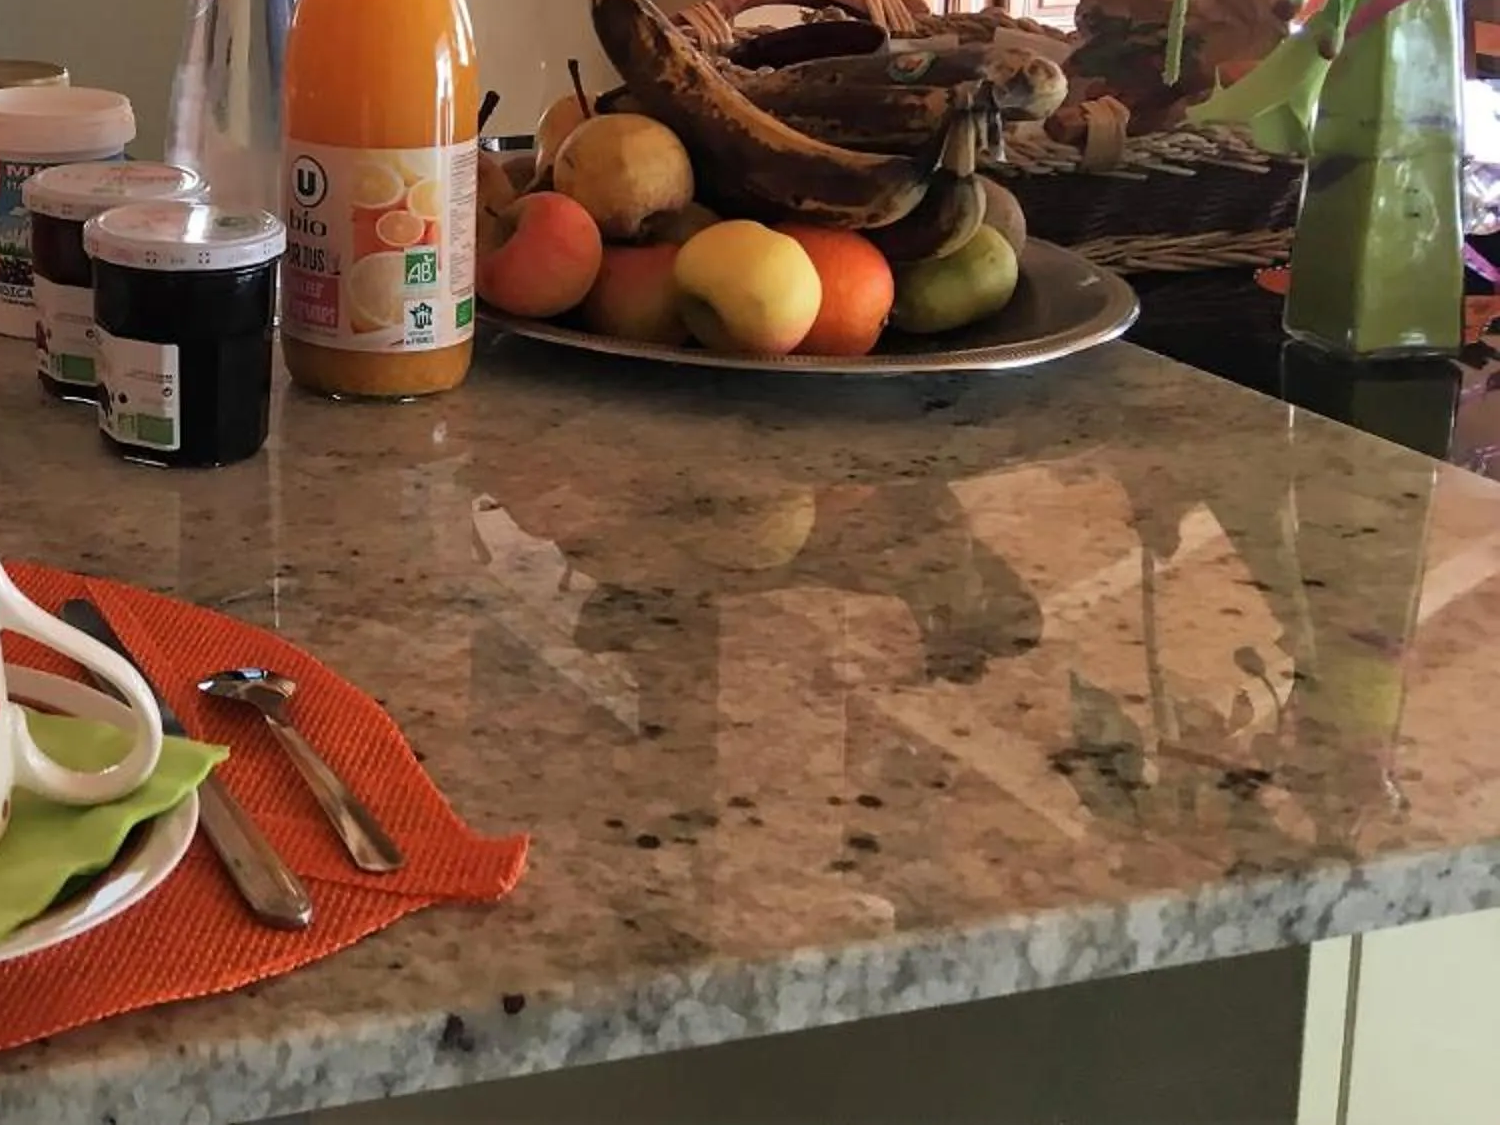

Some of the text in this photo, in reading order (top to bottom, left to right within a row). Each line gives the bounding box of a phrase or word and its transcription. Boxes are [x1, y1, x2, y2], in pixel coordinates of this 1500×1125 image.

[297, 169, 316, 197] U
[289, 208, 327, 237] bio
[407, 261, 433, 284] AB
